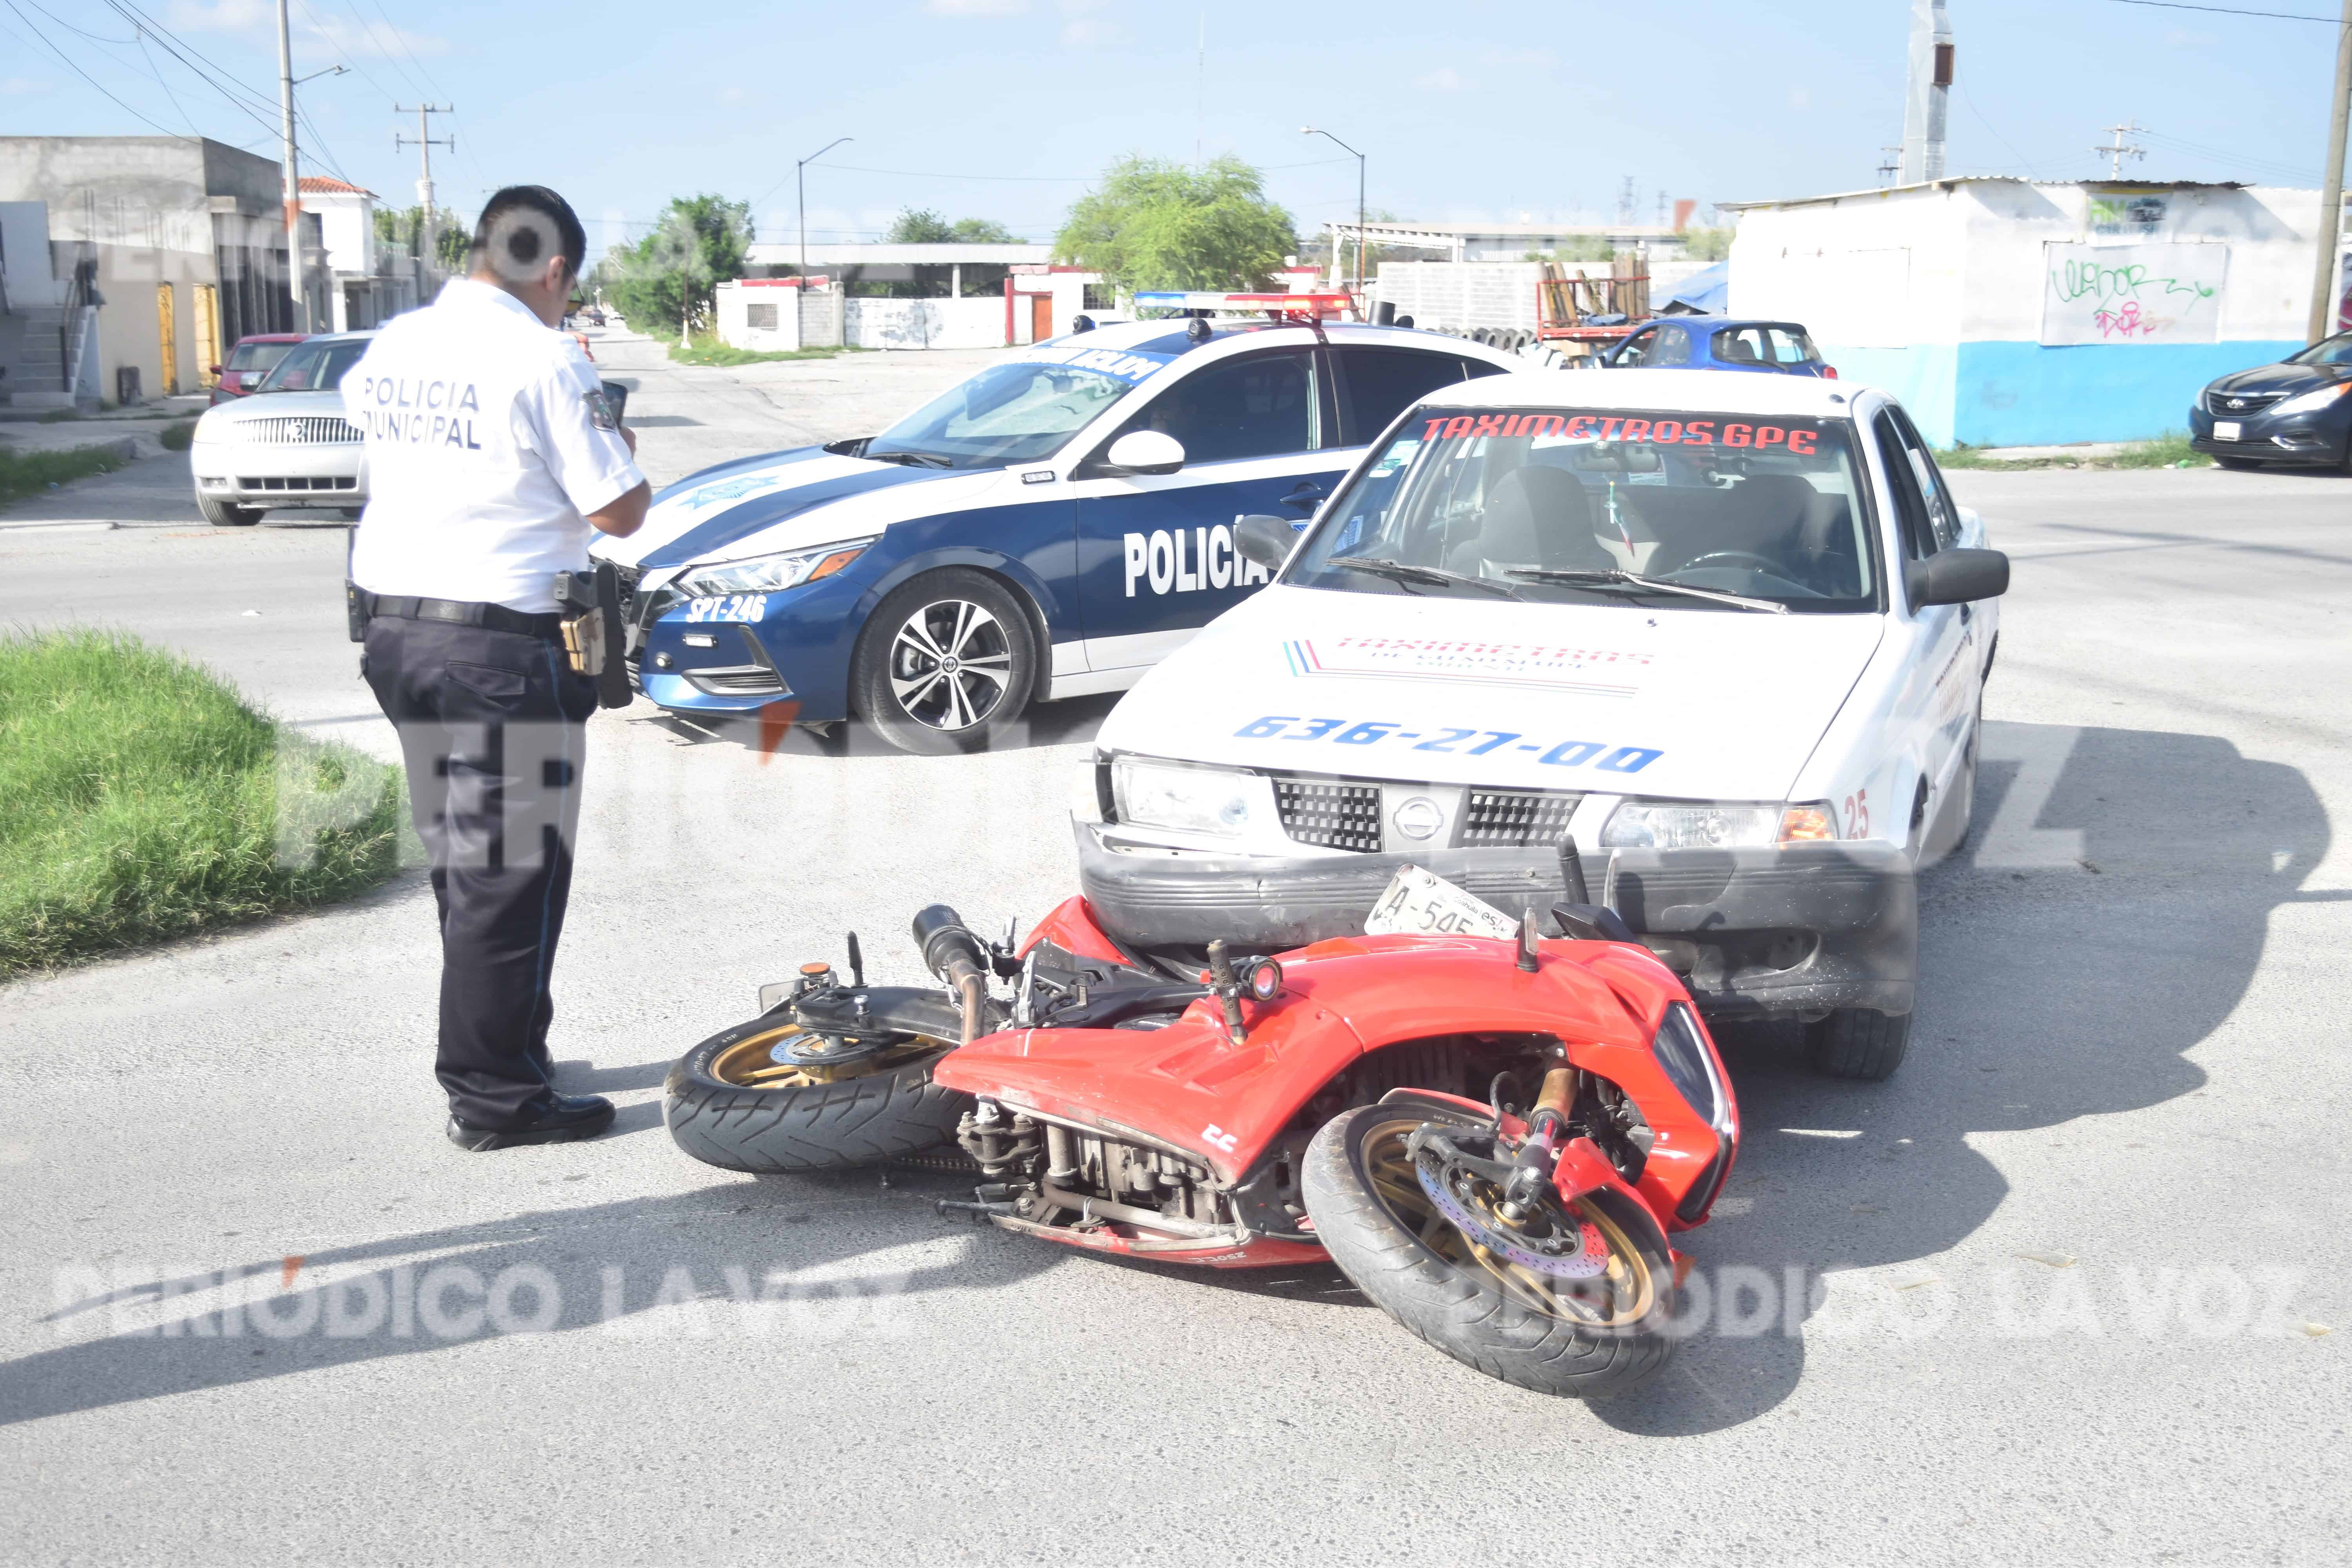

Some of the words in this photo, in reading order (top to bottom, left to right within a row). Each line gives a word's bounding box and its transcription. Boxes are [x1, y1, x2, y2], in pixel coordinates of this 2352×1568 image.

[365, 377, 480, 414] POLICIA
[362, 411, 481, 450] MUNICIPAL
[1424, 414, 1715, 445] TAXIMETROS
[1722, 424, 1817, 455] GPE
[686, 595, 767, 623] SPT-246
[1336, 637, 1655, 665] TAXIMETROS
[1232, 716, 1664, 773] 636-27-00
[1844, 787, 1869, 839] 25
